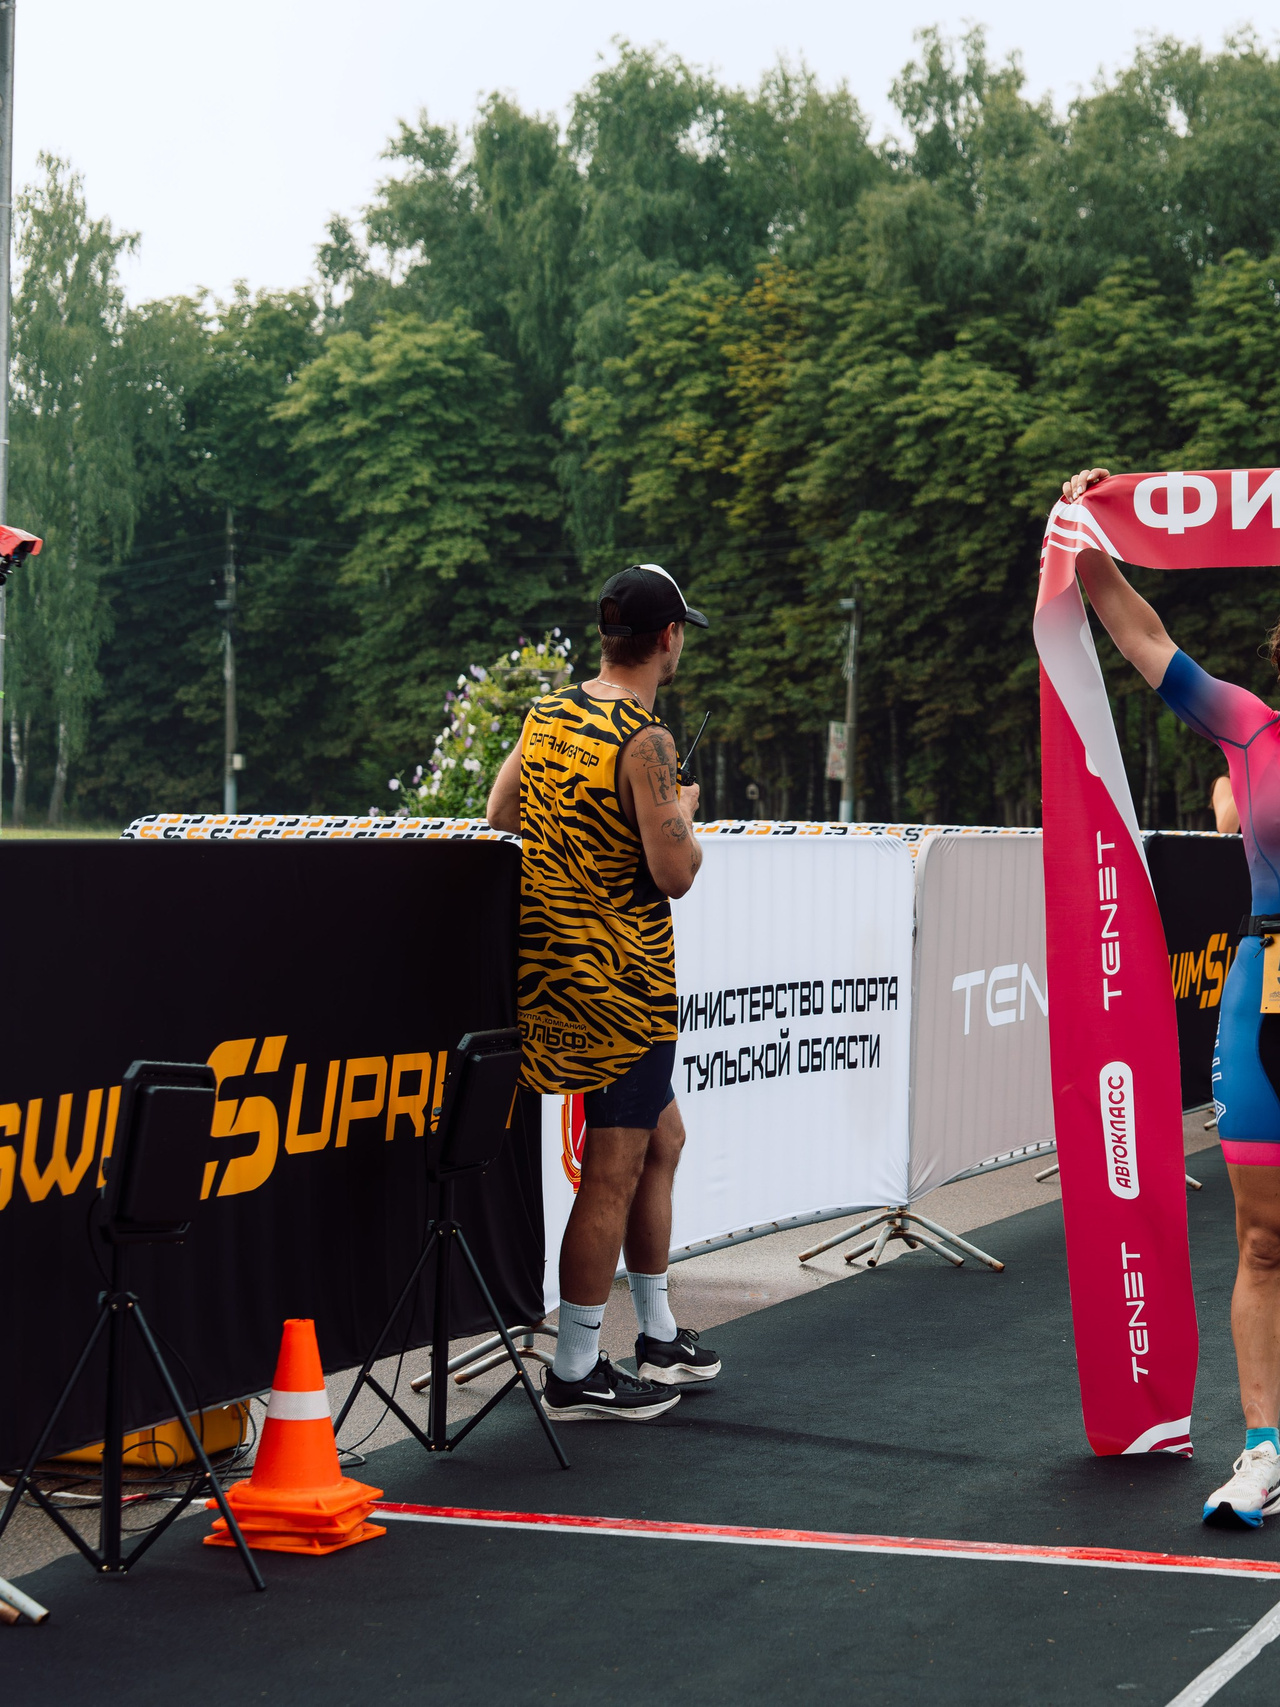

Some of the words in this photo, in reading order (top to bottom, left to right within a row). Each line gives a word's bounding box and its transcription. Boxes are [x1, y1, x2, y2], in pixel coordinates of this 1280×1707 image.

[1096, 830, 1121, 1011] TENET
[544, 1019, 587, 1031] КОМПАНИЙ
[677, 980, 824, 1034] ИНИСТЕРСТВО
[831, 976, 899, 1014] СПОРТА
[951, 962, 1048, 1036] TEN
[518, 1021, 587, 1049] ЭЛЬФ
[683, 1027, 791, 1093] ТУЛЬСКОЙ
[798, 1034, 881, 1074] ОБЛАСТИ
[1105, 1074, 1132, 1190] АВТОКЛАСС
[1121, 1240, 1149, 1384] TENET
